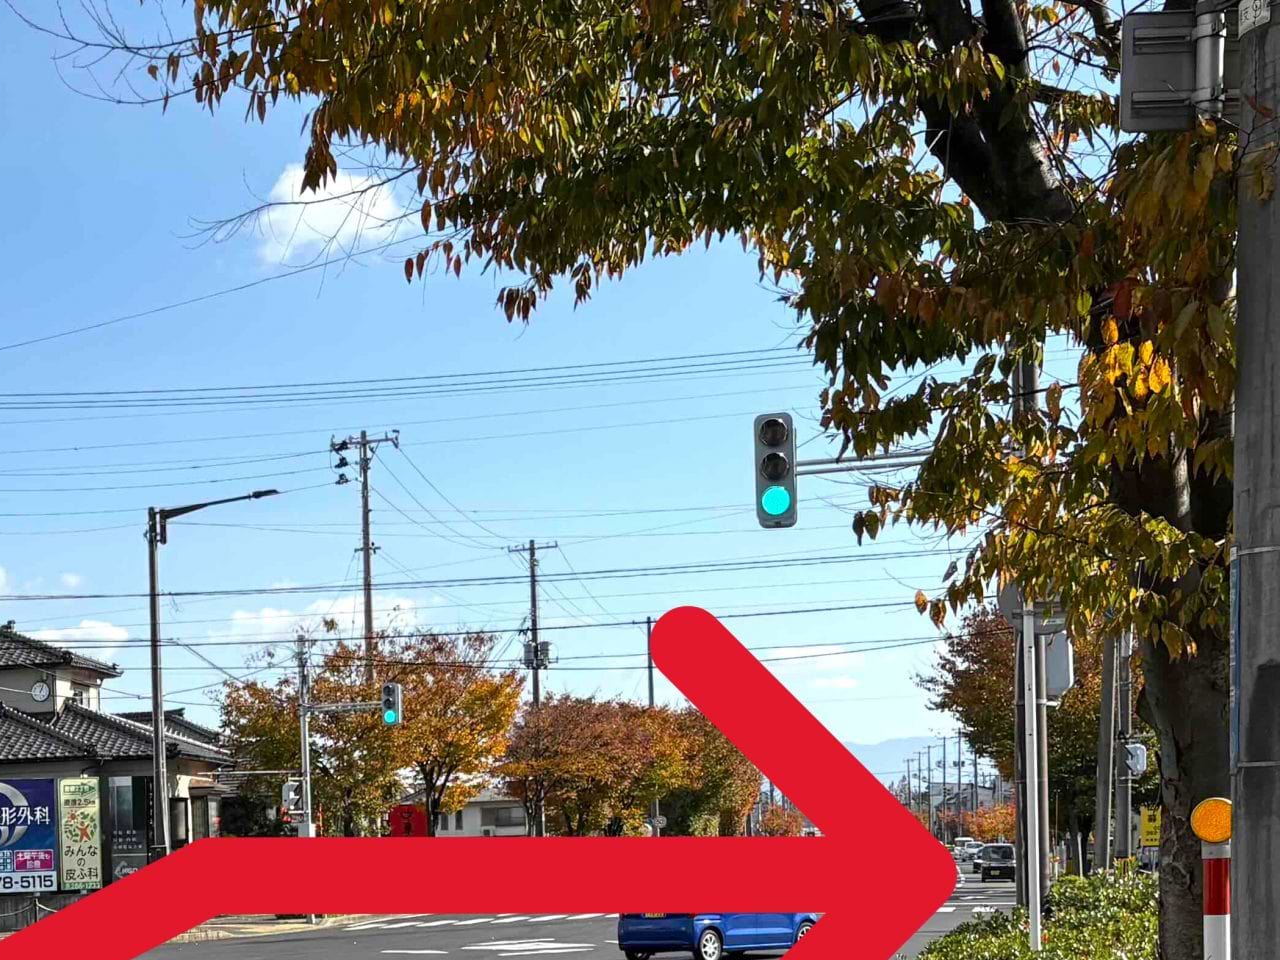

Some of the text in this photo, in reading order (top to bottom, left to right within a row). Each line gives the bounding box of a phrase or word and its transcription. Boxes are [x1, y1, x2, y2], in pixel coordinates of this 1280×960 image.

[64, 845, 98, 857] みんな
[76, 857, 86, 867] の
[65, 867, 99, 881] 皮ふ科
